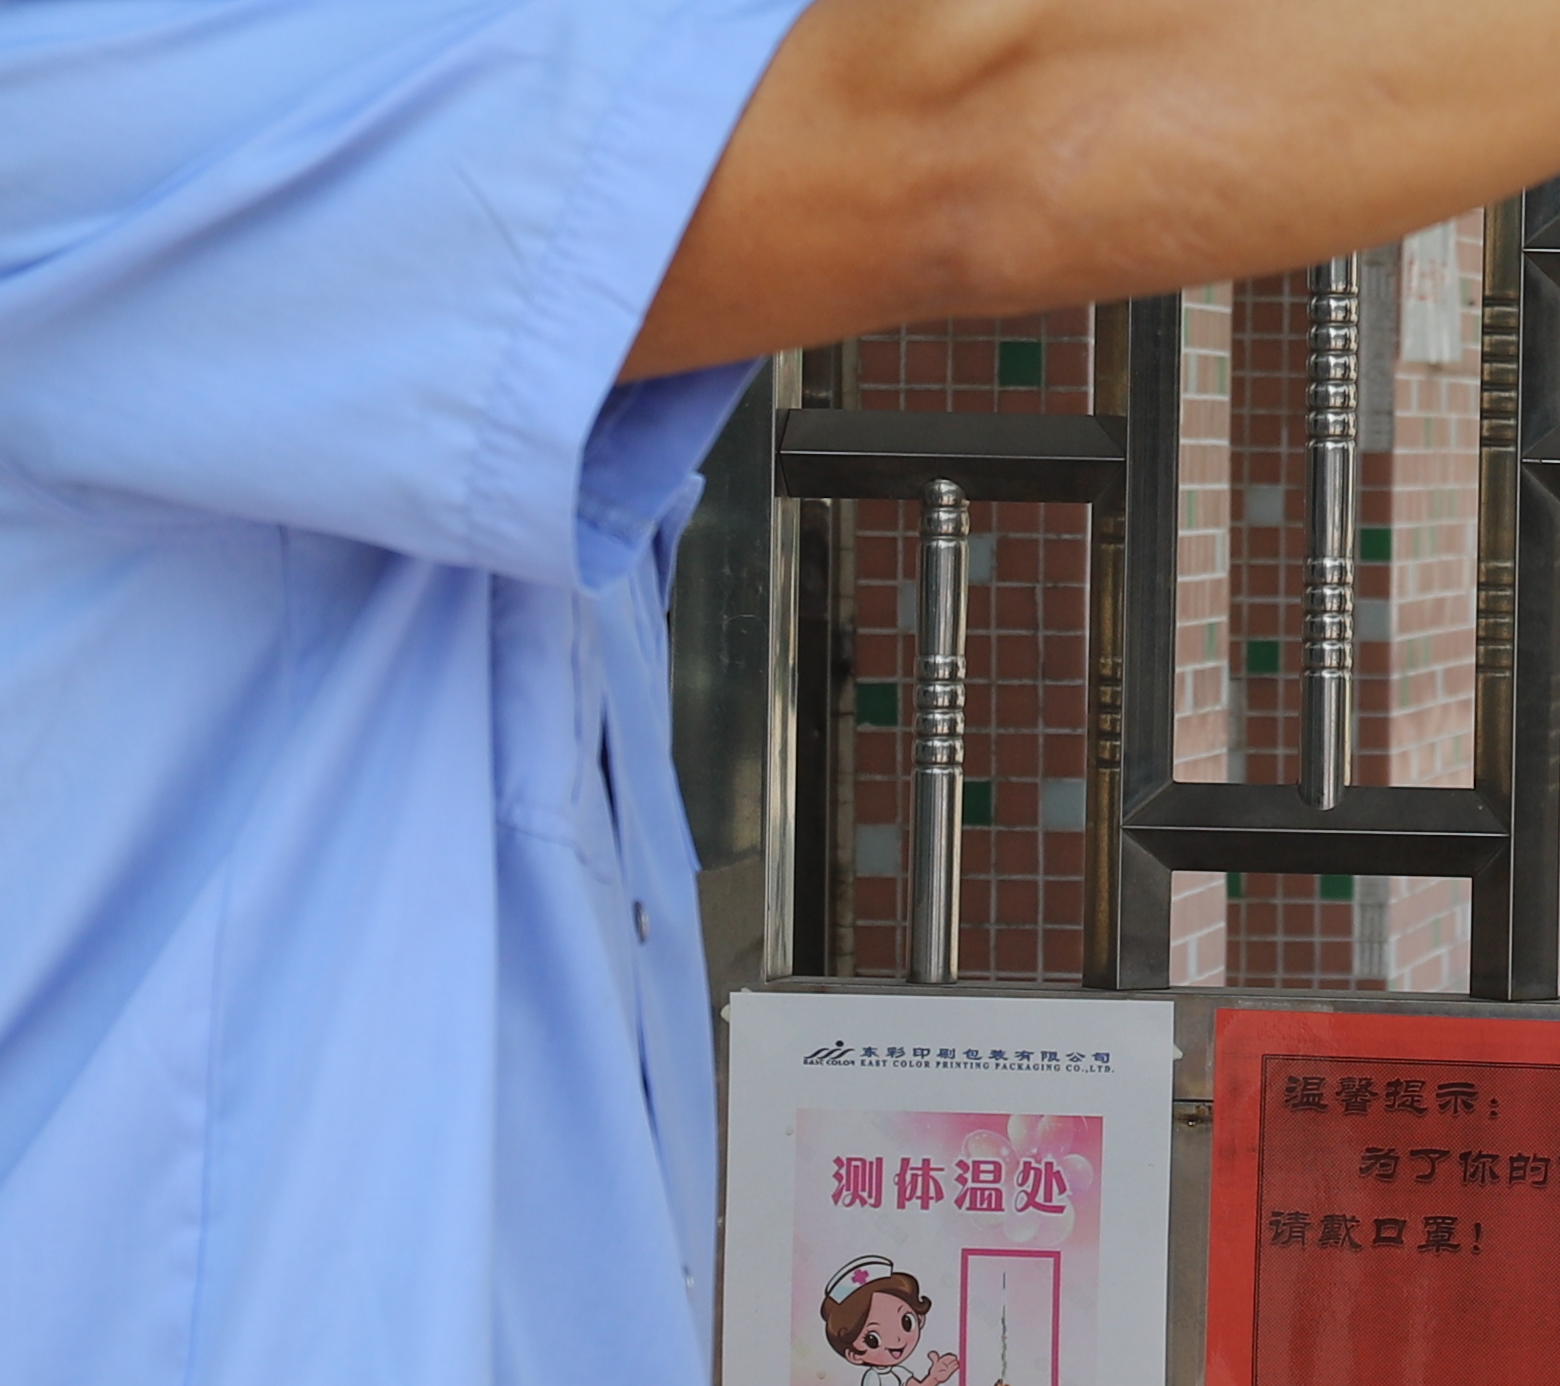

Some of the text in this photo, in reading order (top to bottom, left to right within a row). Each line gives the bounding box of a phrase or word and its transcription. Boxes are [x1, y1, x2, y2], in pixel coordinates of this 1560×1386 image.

[860, 1046, 1111, 1064] 东彩印刷包装有限公司
[860, 1059, 888, 1068] EAST
[892, 1060, 931, 1069] COLOR
[935, 1061, 990, 1070] PRINTING
[994, 1062, 1061, 1072] PACKAGING
[1282, 1074, 1500, 1121] 温馨提示：
[831, 1155, 1069, 1214] 测体温处
[1267, 1210, 1485, 1256] 请戴口罩！
